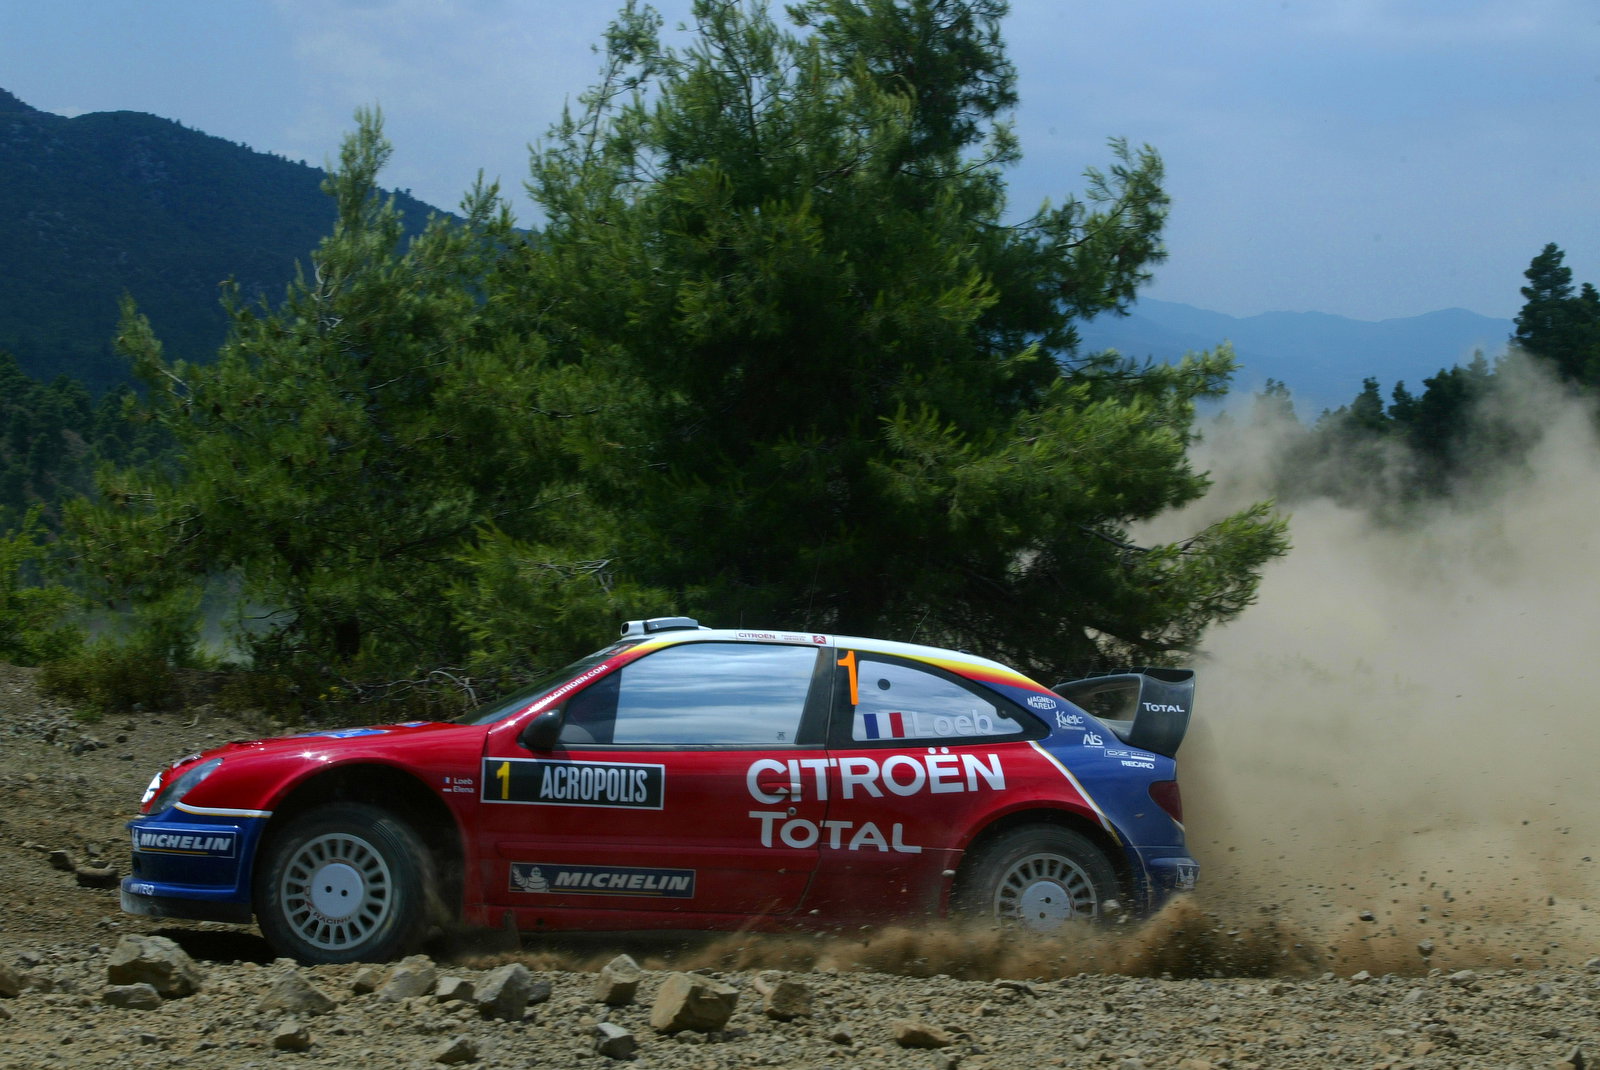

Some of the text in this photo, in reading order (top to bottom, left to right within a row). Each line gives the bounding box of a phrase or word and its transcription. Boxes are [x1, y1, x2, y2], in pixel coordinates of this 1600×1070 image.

[837, 650, 859, 706] 1
[1142, 702, 1185, 713] TOTAL
[911, 709, 994, 737] Loeb
[746, 747, 1006, 805] CITROËN
[1120, 760, 1155, 770] RECARO
[453, 777, 474, 785] Loeb
[496, 761, 648, 803] 1 ACROPOLIS
[140, 833, 231, 851] MICHELIN
[749, 811, 922, 854] TOTAL
[554, 872, 691, 891] MICHELIN
